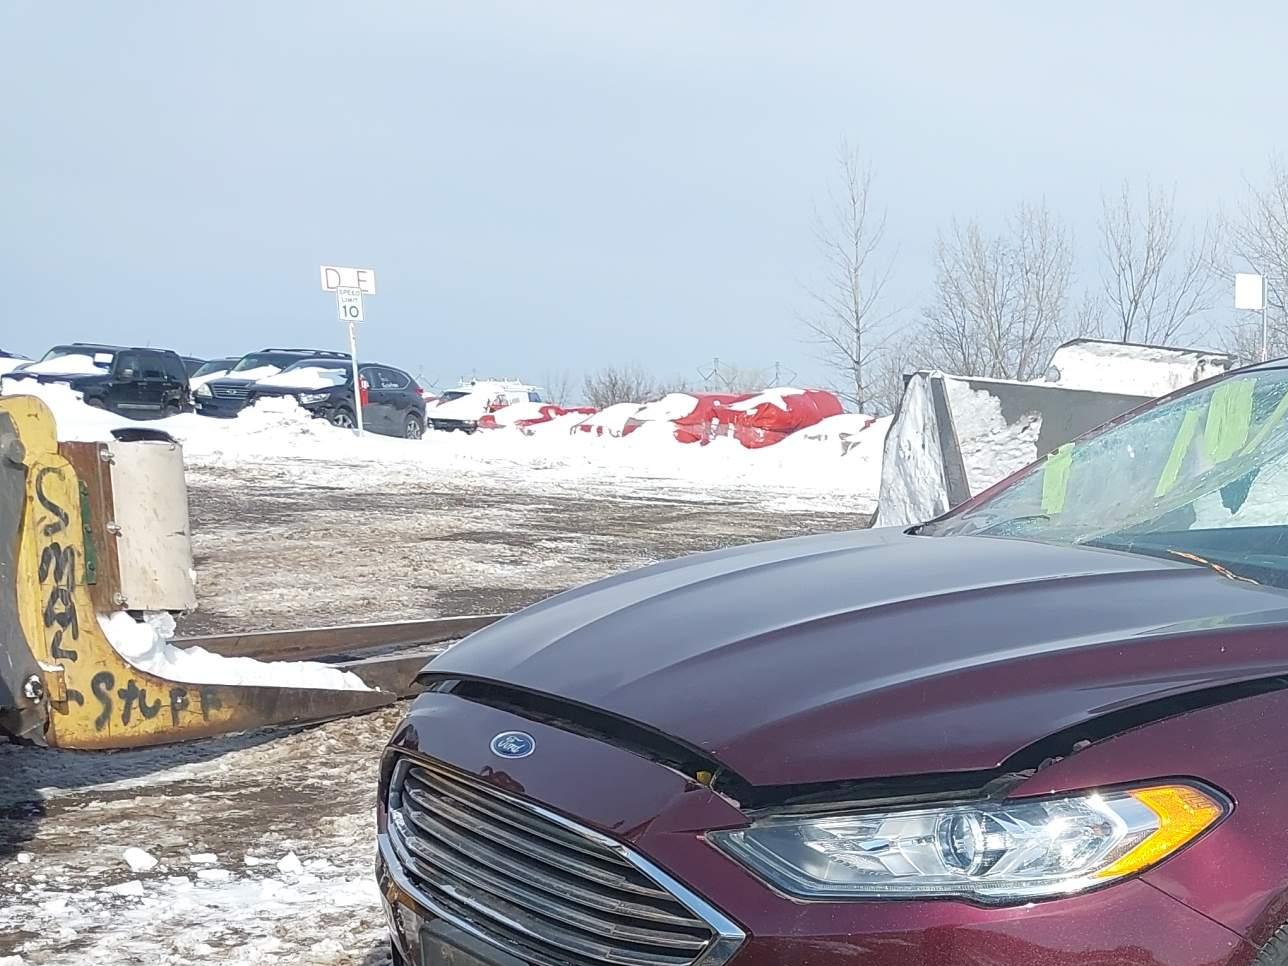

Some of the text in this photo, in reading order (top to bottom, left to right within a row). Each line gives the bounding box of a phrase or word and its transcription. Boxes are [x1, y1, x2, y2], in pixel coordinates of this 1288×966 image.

[325, 268, 369, 292] D E
[342, 305, 360, 318] 10
[497, 735, 526, 753] Ford
